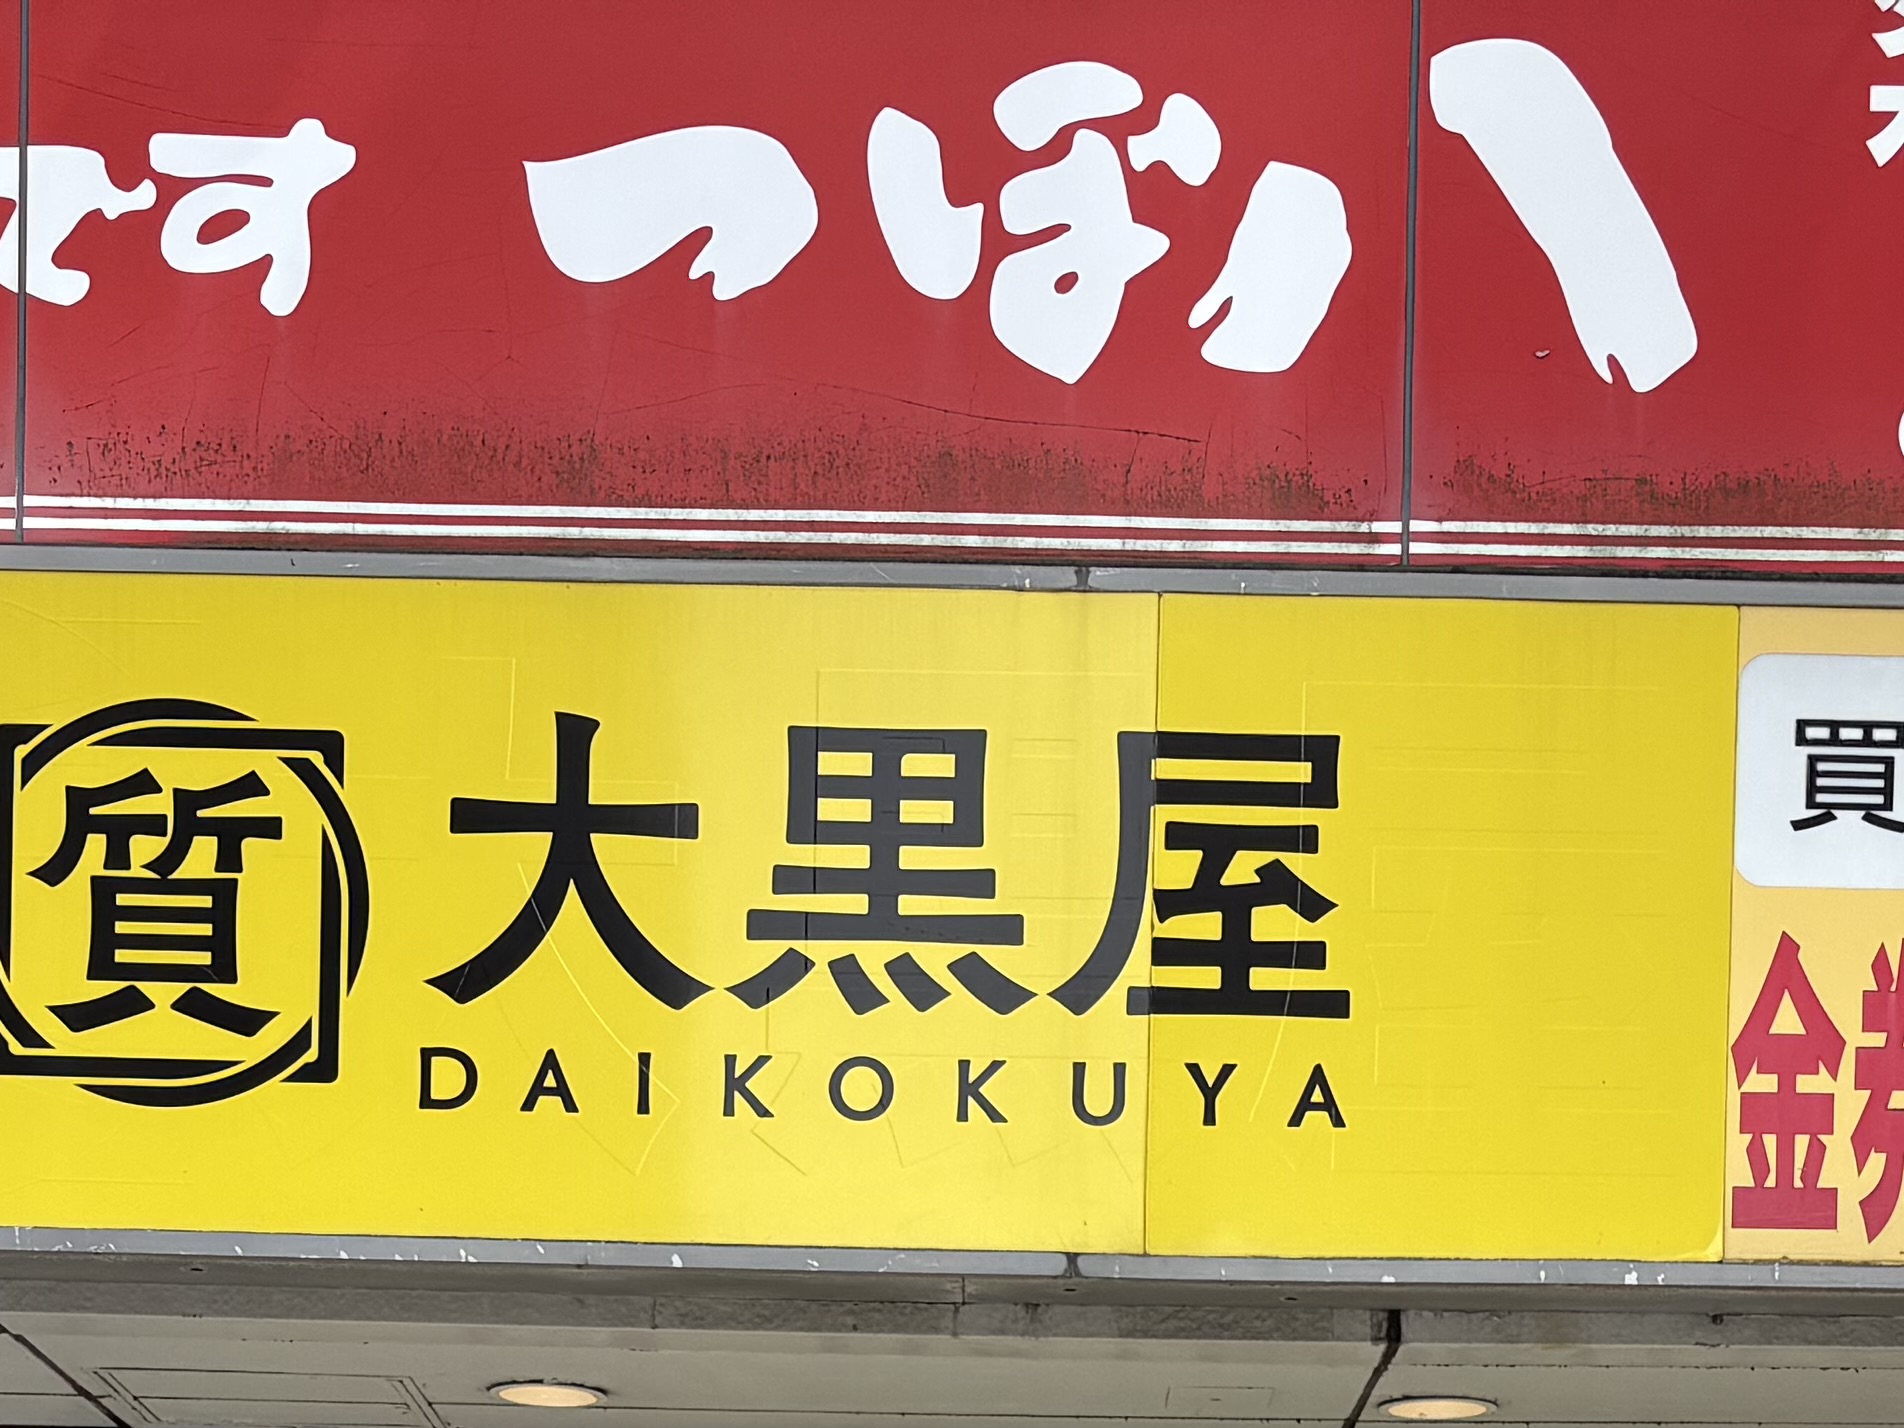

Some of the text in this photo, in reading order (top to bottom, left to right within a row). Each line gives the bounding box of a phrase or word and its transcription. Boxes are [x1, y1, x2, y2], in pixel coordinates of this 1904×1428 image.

[525, 37, 1699, 394] つぼ八
[30, 769, 283, 1035] 質
[424, 711, 1350, 1018] 大黒屋
[419, 1047, 1346, 1129] DAIKOKUYA
